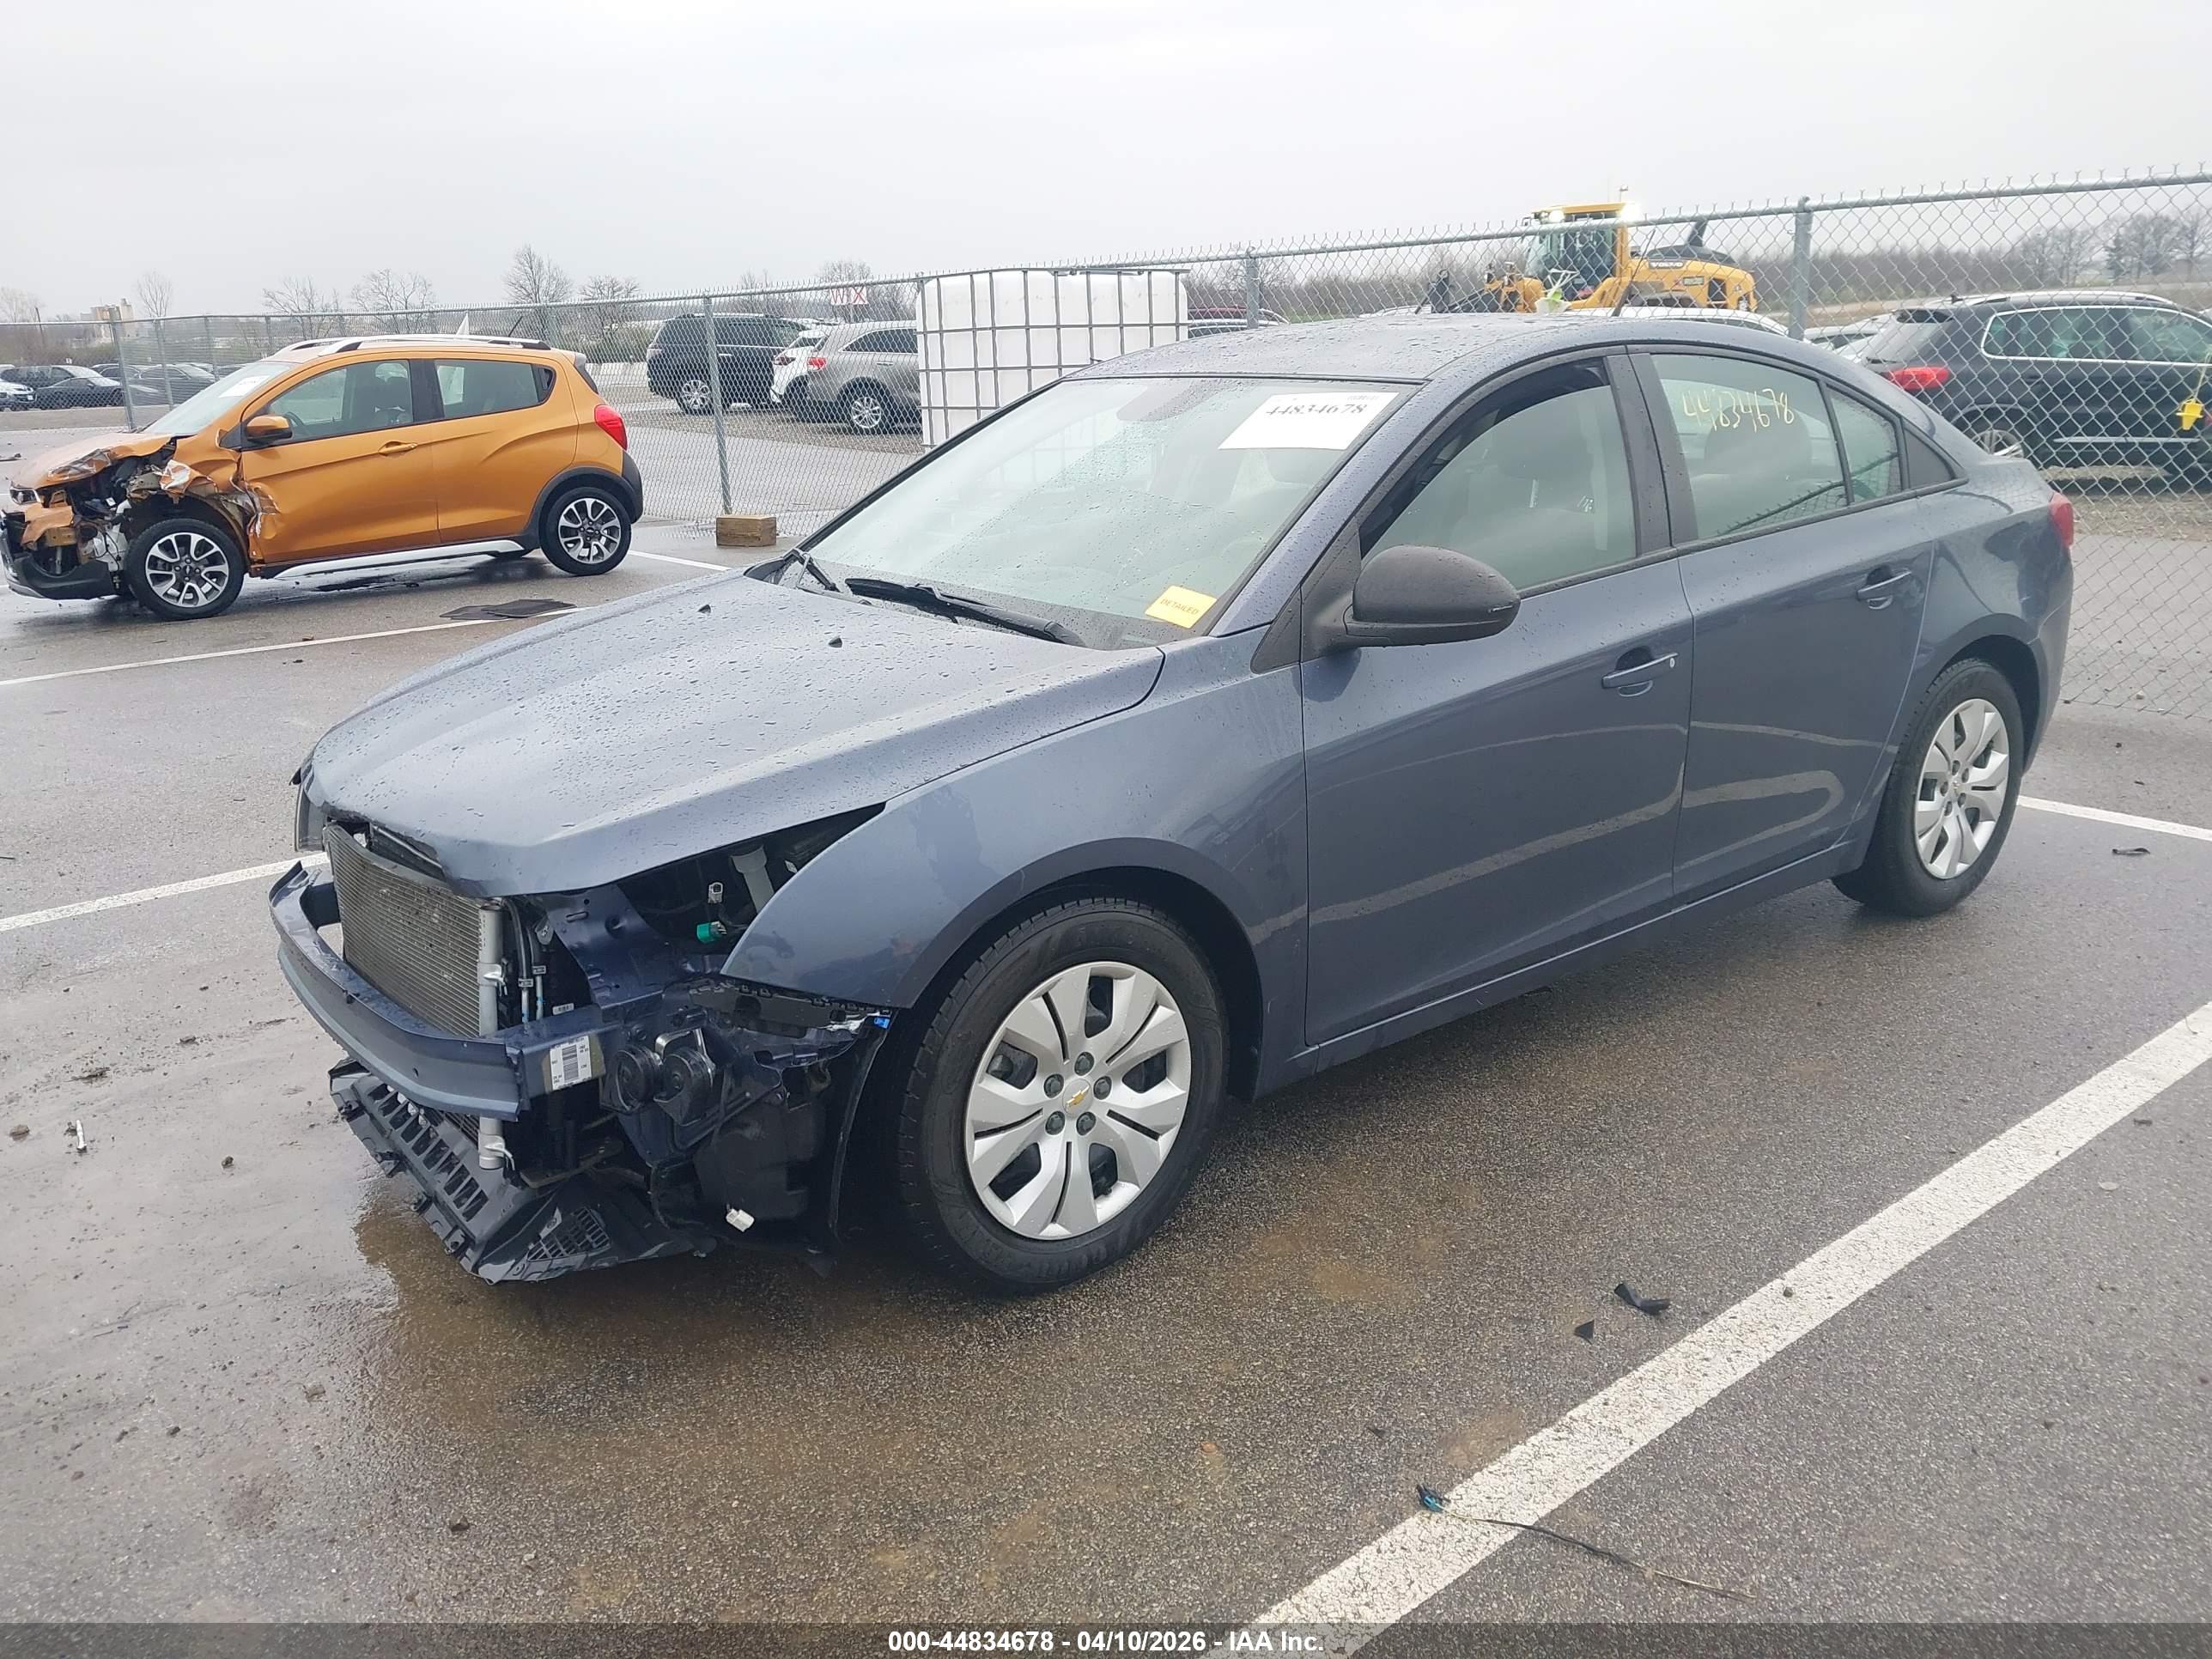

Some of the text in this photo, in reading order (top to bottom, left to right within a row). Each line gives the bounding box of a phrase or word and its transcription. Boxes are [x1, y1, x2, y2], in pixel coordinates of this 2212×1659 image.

[1266, 404, 1367, 416] 44834678
[1682, 388, 1795, 433] 44834678
[1159, 598, 1200, 615] DETAILED
